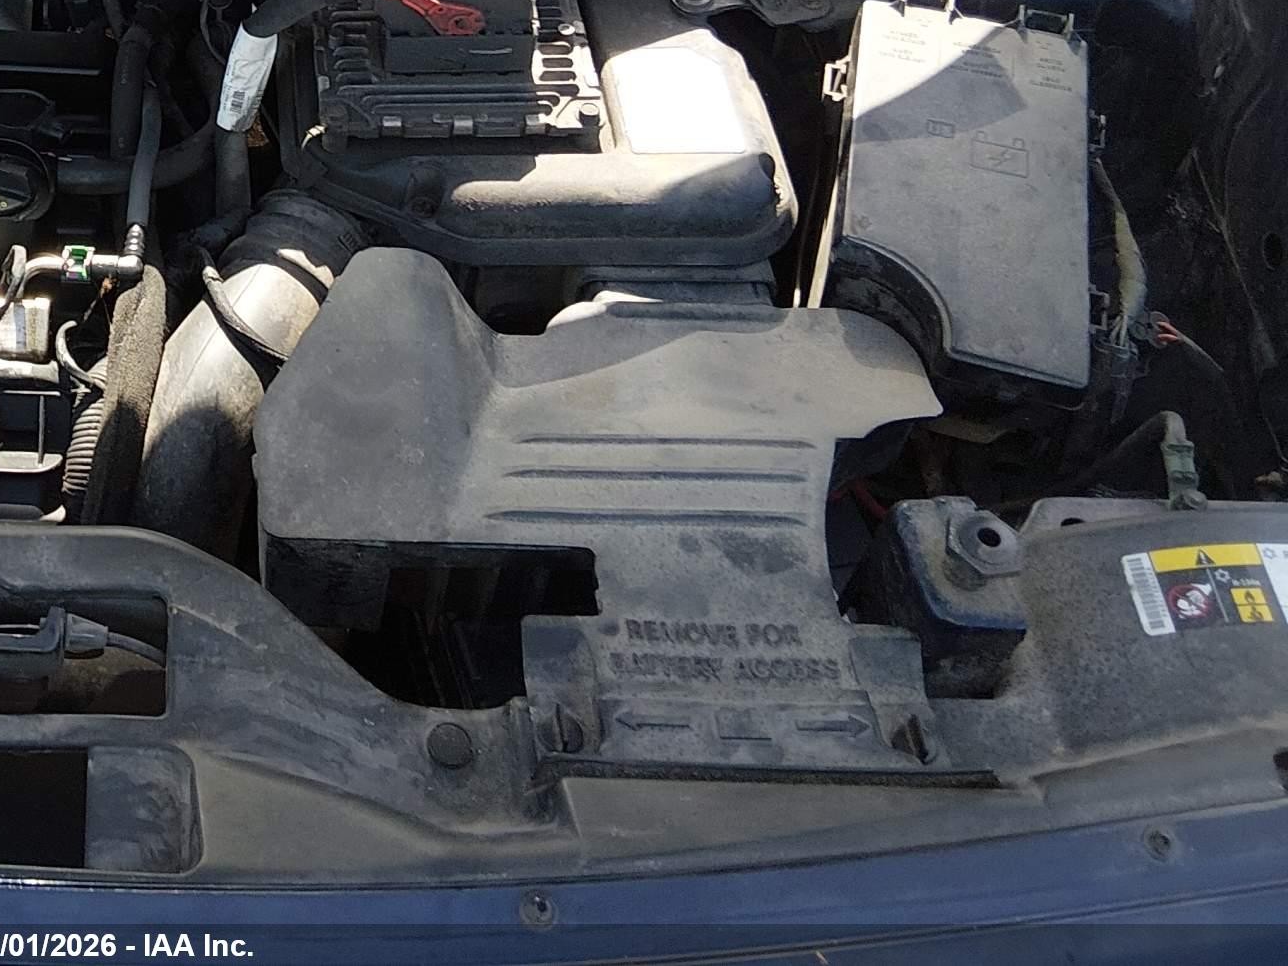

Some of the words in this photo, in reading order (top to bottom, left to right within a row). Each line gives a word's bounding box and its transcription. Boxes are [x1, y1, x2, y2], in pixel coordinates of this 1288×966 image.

[625, 618, 740, 649] REMOVE
[745, 623, 803, 646] FOR
[610, 651, 723, 681] BATTERY
[734, 658, 842, 682] ACCESS
